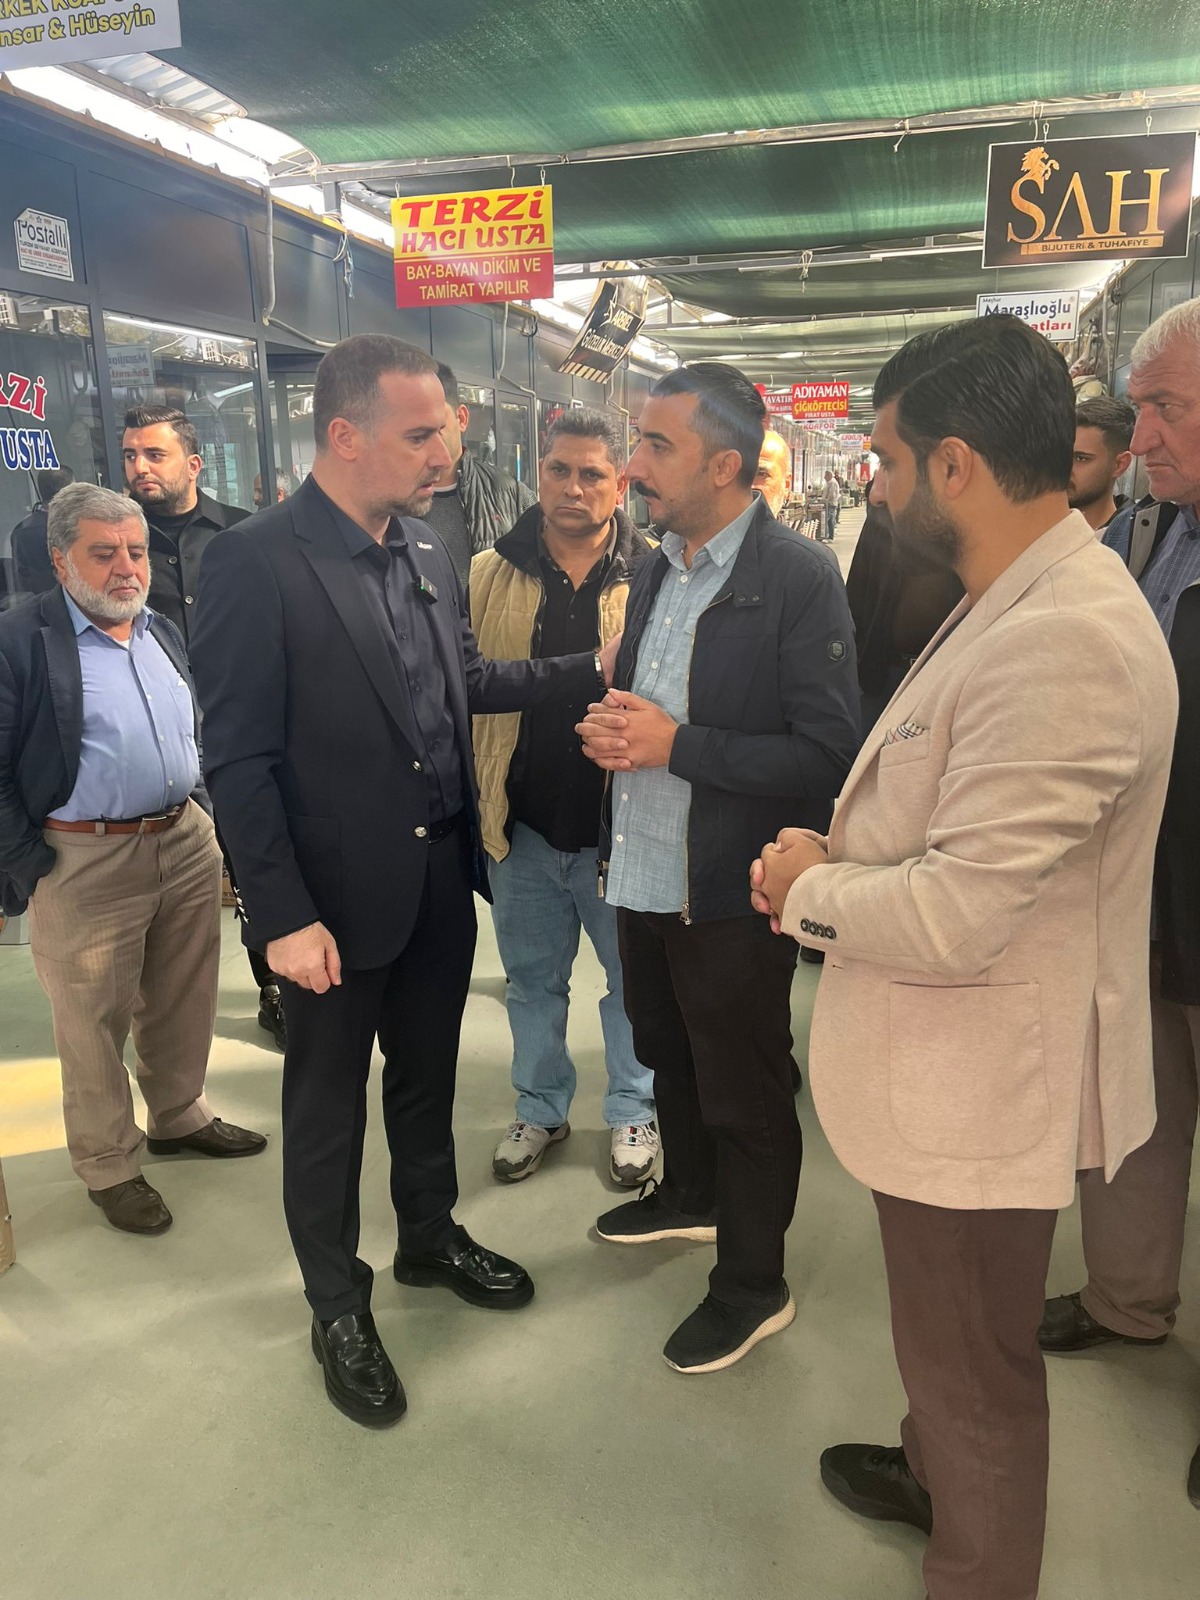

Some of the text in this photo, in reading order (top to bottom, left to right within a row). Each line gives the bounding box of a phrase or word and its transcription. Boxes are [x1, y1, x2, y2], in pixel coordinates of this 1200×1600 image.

[48, 17, 66, 40] &
[68, 3, 156, 36] Hüseyin
[401, 224, 545, 253] HACI USTA
[406, 256, 541, 281] BAY-BAYAN DİKİM VE
[419, 280, 529, 300] TAMİRAT YAPILIR
[1029, 320, 1071, 331] atları
[794, 384, 847, 398] ADIYAMAN
[0, 428, 60, 470] USTA
